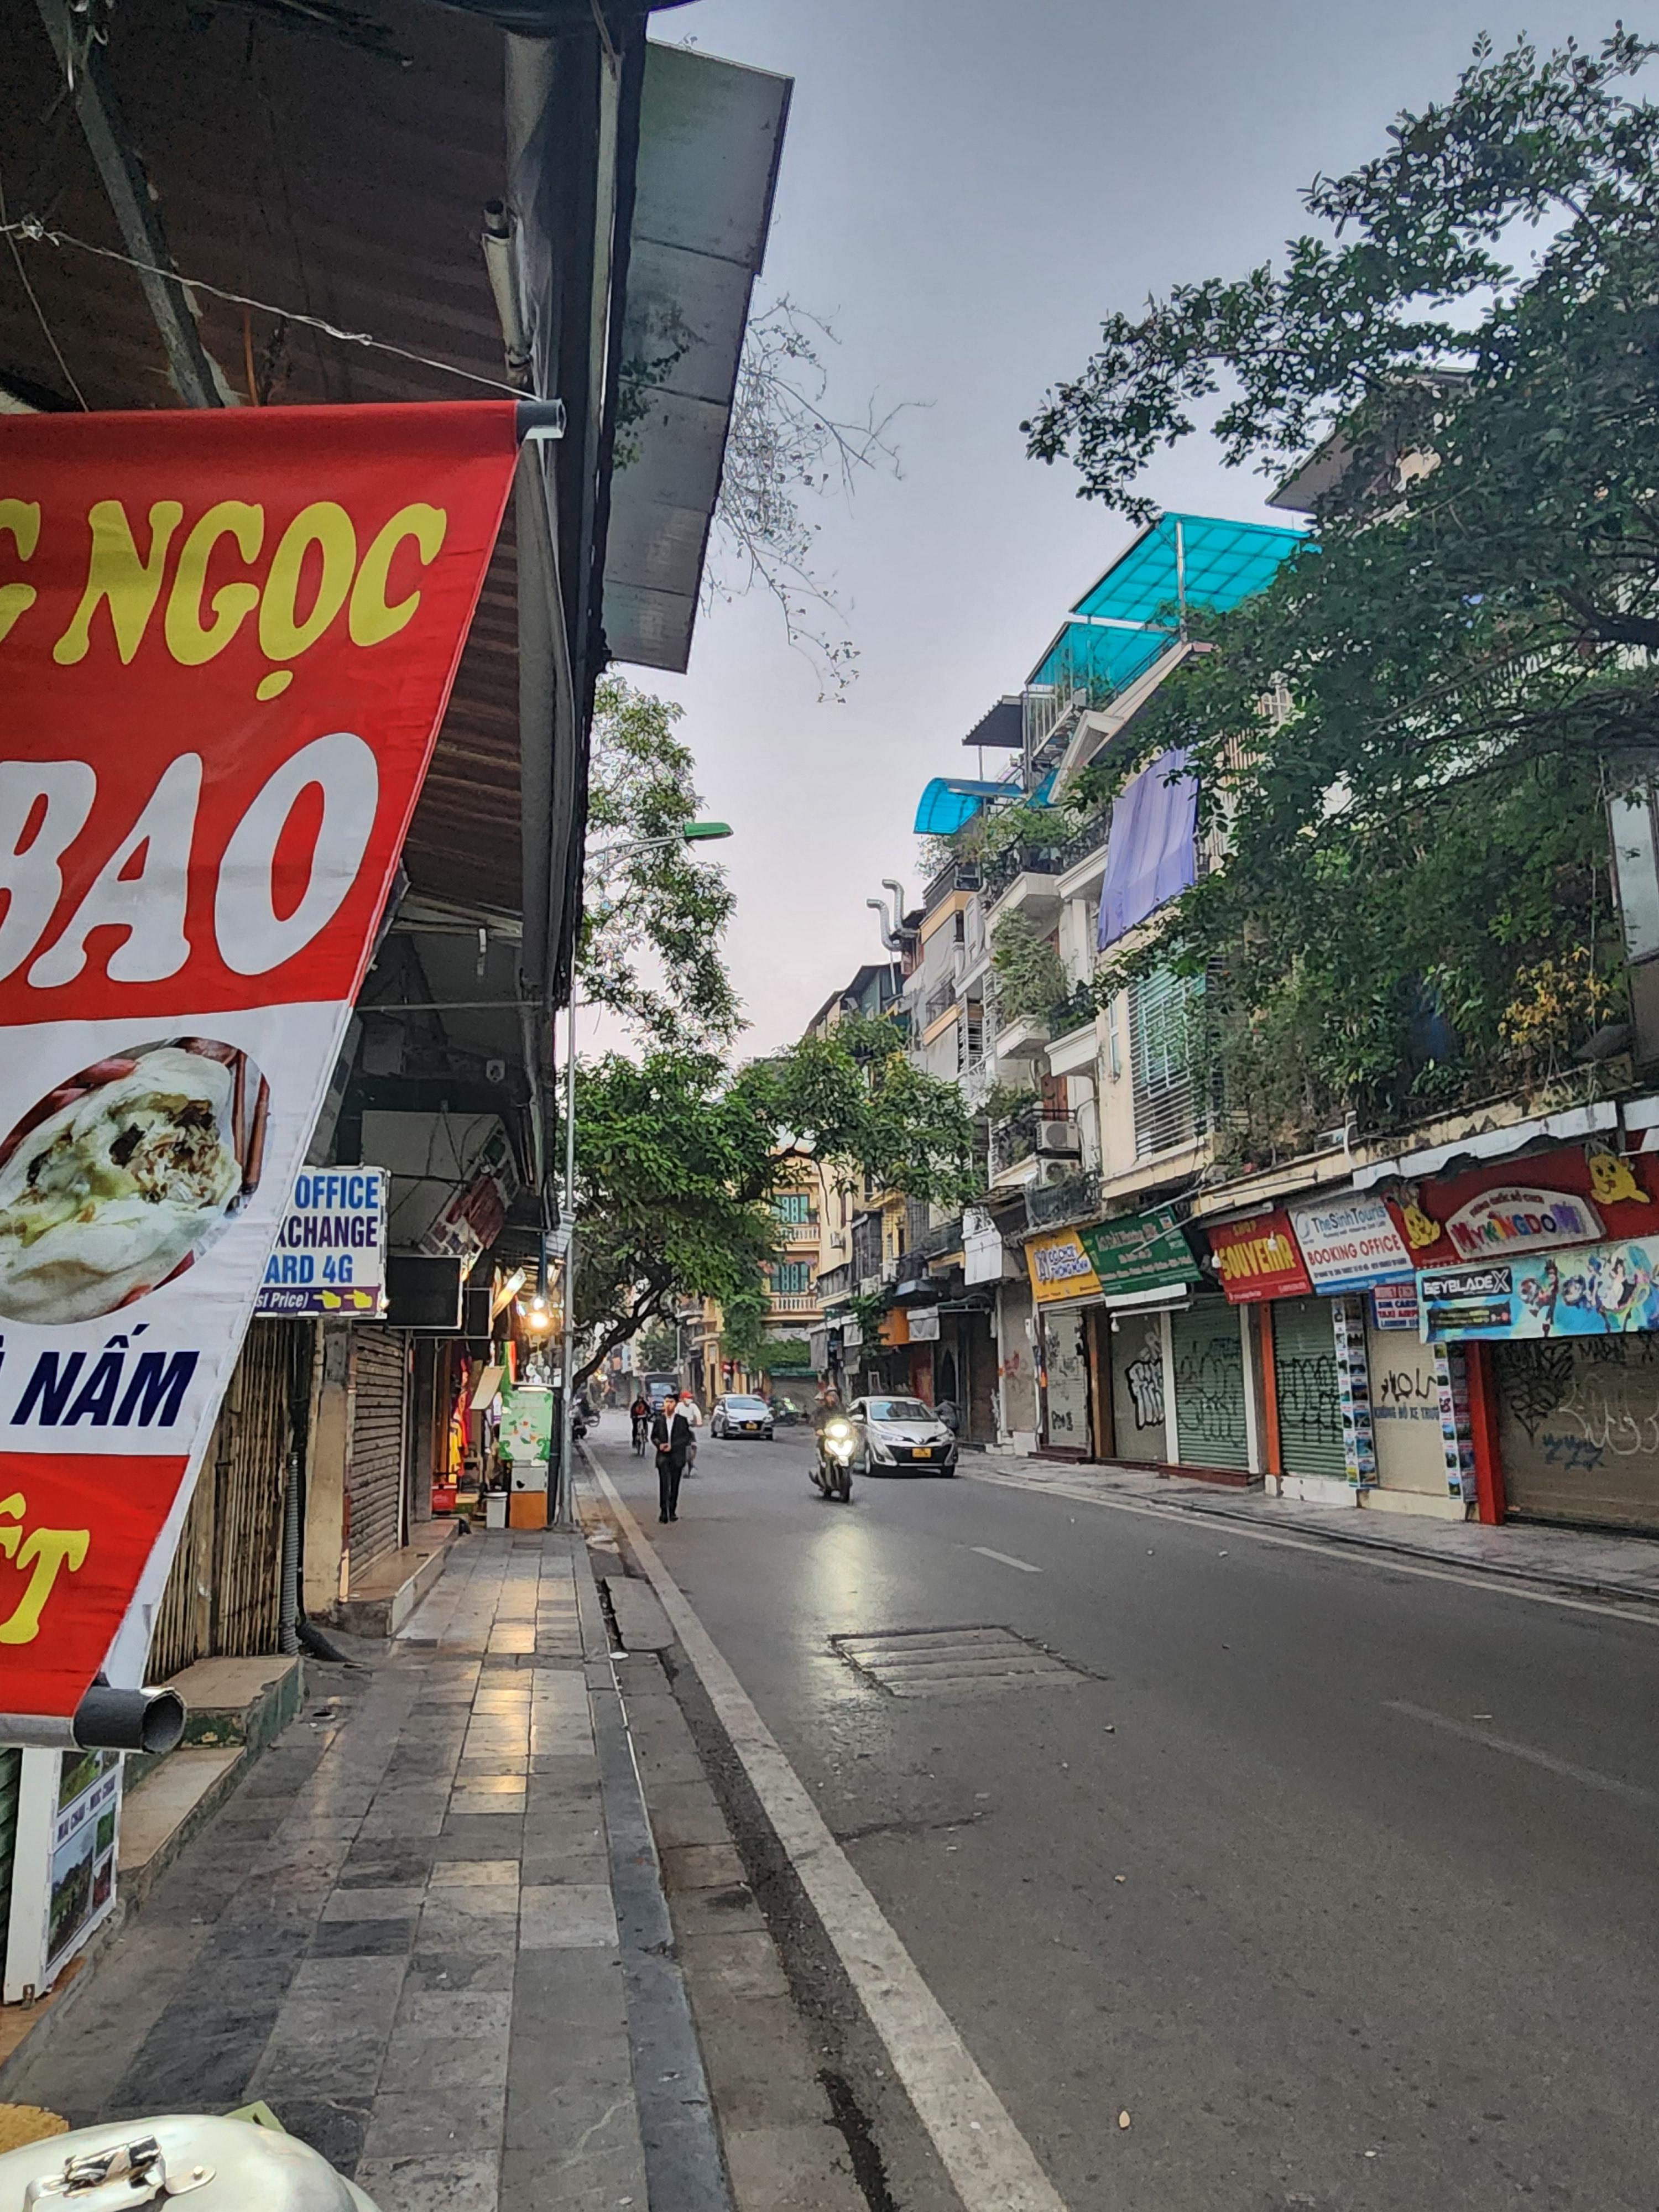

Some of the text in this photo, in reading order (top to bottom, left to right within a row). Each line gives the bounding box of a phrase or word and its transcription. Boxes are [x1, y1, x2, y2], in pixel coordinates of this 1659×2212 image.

[54, 500, 446, 701] NGỌC
[295, 1175, 379, 1209] OFFICE
[275, 1215, 378, 1248] XCHANGE
[1307, 1234, 1401, 1266] BOOKING OFFICE
[264, 1254, 353, 1284] ARD 4G
[255, 1292, 269, 1308] st
[9, 1323, 200, 1427] NẤM
